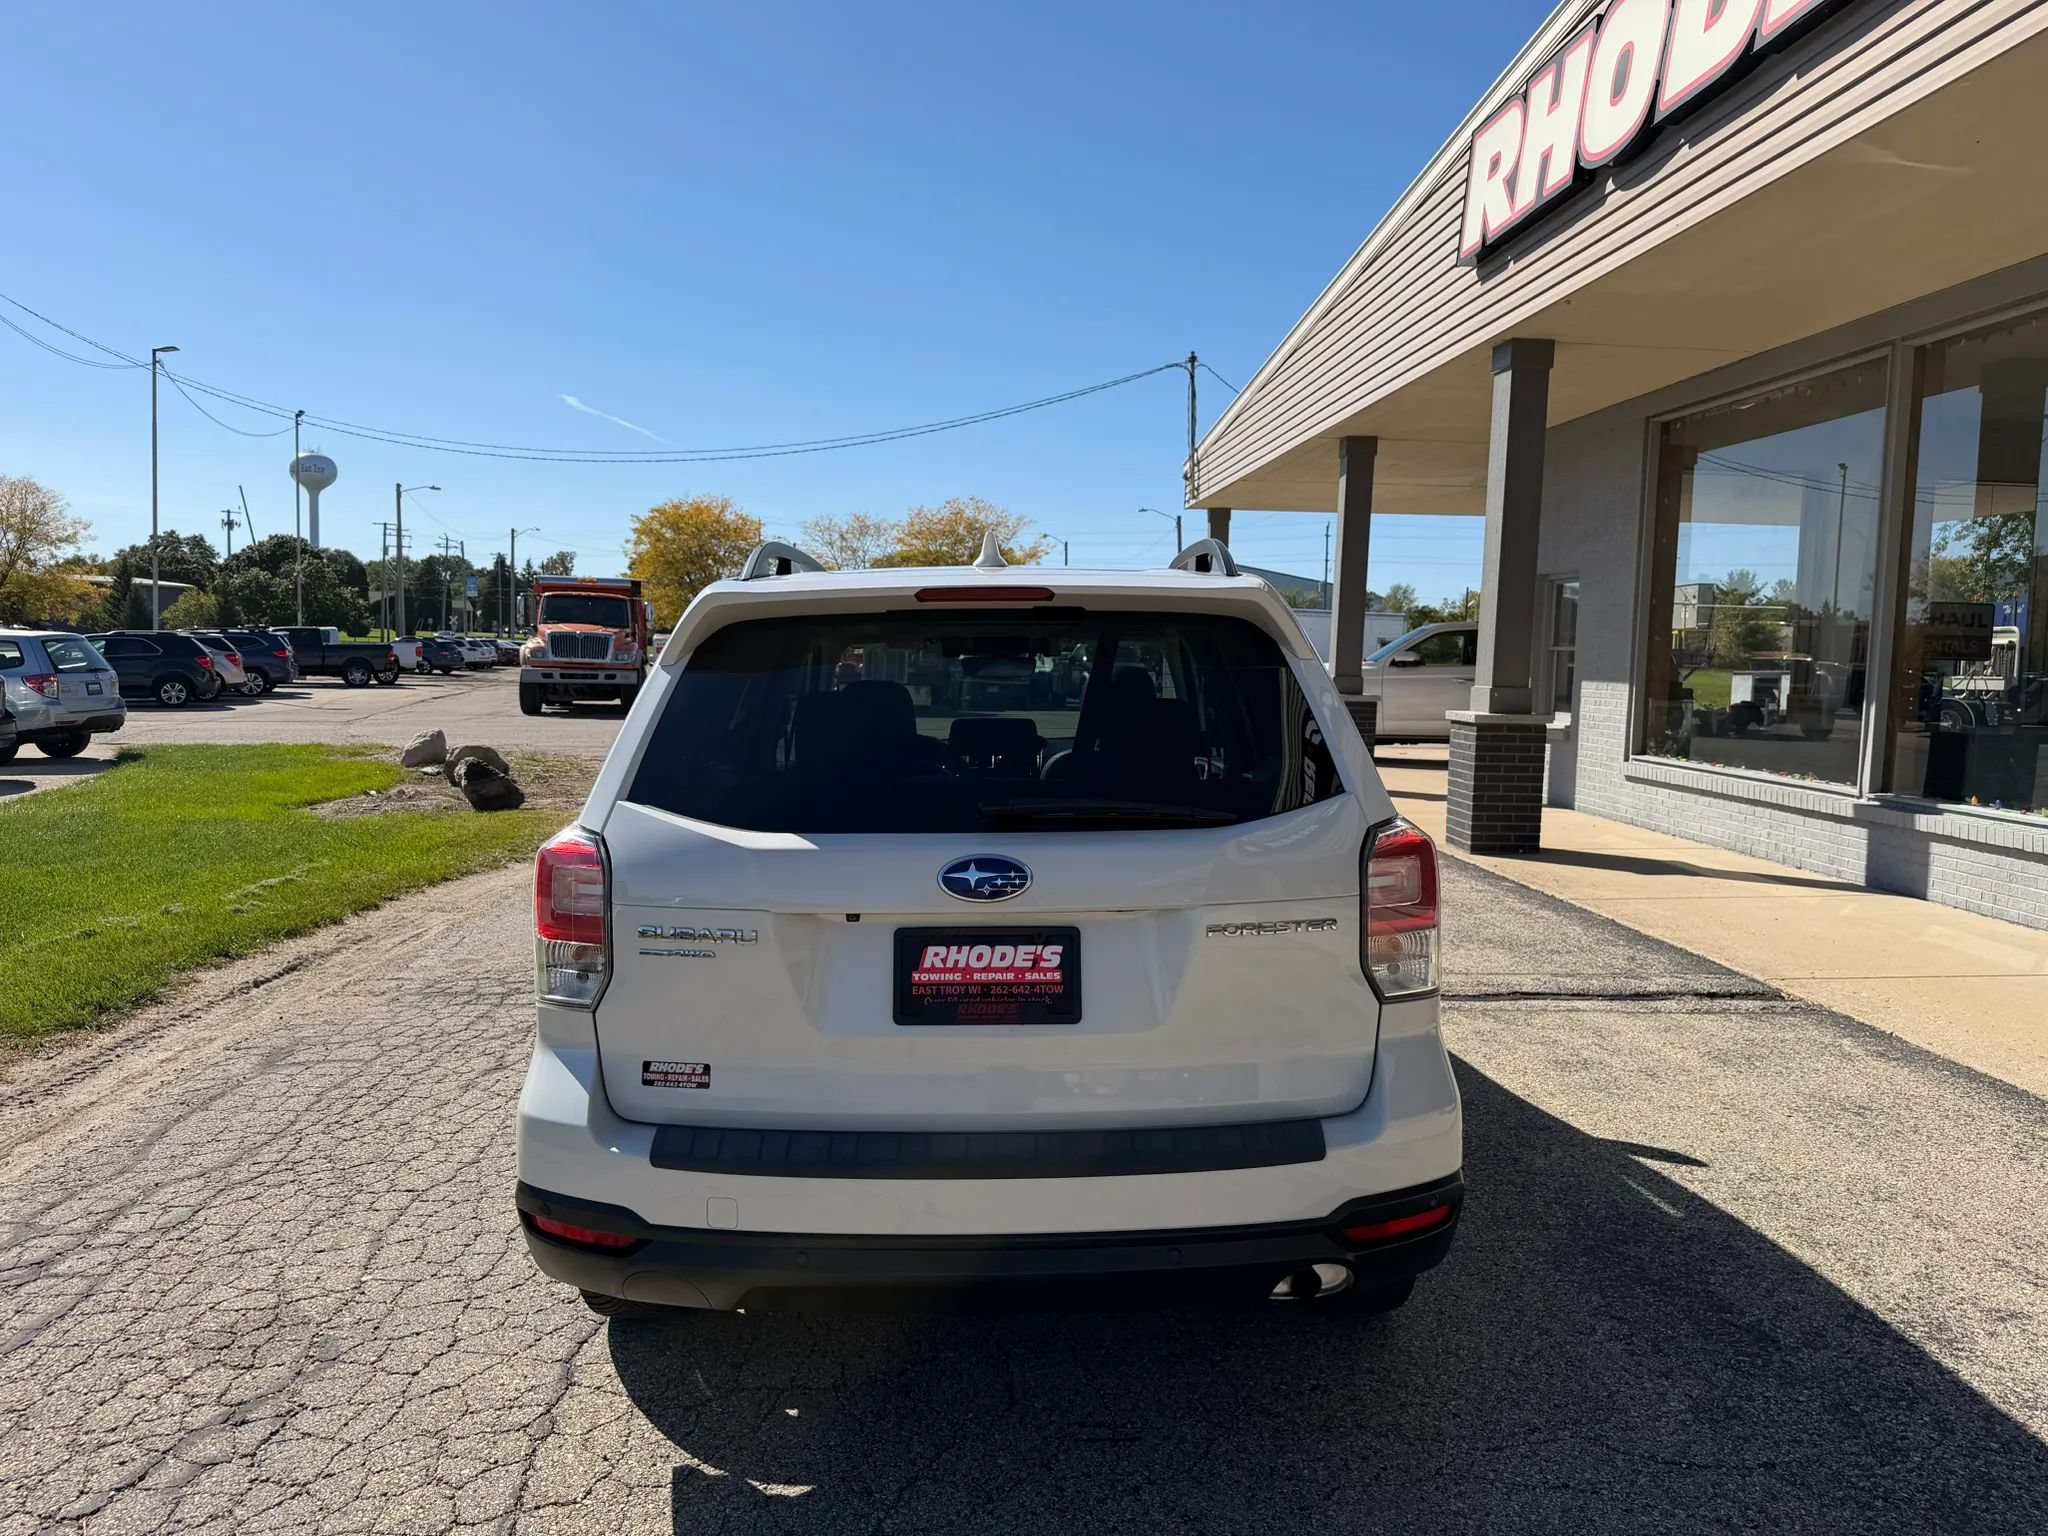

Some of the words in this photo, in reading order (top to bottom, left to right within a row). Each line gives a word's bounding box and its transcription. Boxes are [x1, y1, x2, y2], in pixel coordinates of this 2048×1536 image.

[1459, 0, 1816, 259] RHOD
[313, 464, 325, 476] Troy
[1924, 611, 1989, 628] HAUL
[1922, 639, 1979, 654] ENTALS
[636, 924, 758, 944] SUBARU
[1206, 918, 1338, 938] FORESTER
[922, 945, 1064, 968] RHODE'S
[913, 973, 962, 981] TOWING
[973, 972, 1015, 980] REPAIR
[1025, 972, 1061, 980] SALES
[912, 986, 937, 995] EAST
[940, 986, 966, 995] TROY
[968, 985, 981, 995] WI
[990, 985, 1064, 995] 262-642-4TOW
[650, 1062, 705, 1074] RHODE'S
[643, 1072, 665, 1081] TOWING
[667, 1074, 688, 1082] REPAIR
[691, 1075, 710, 1083] SALES
